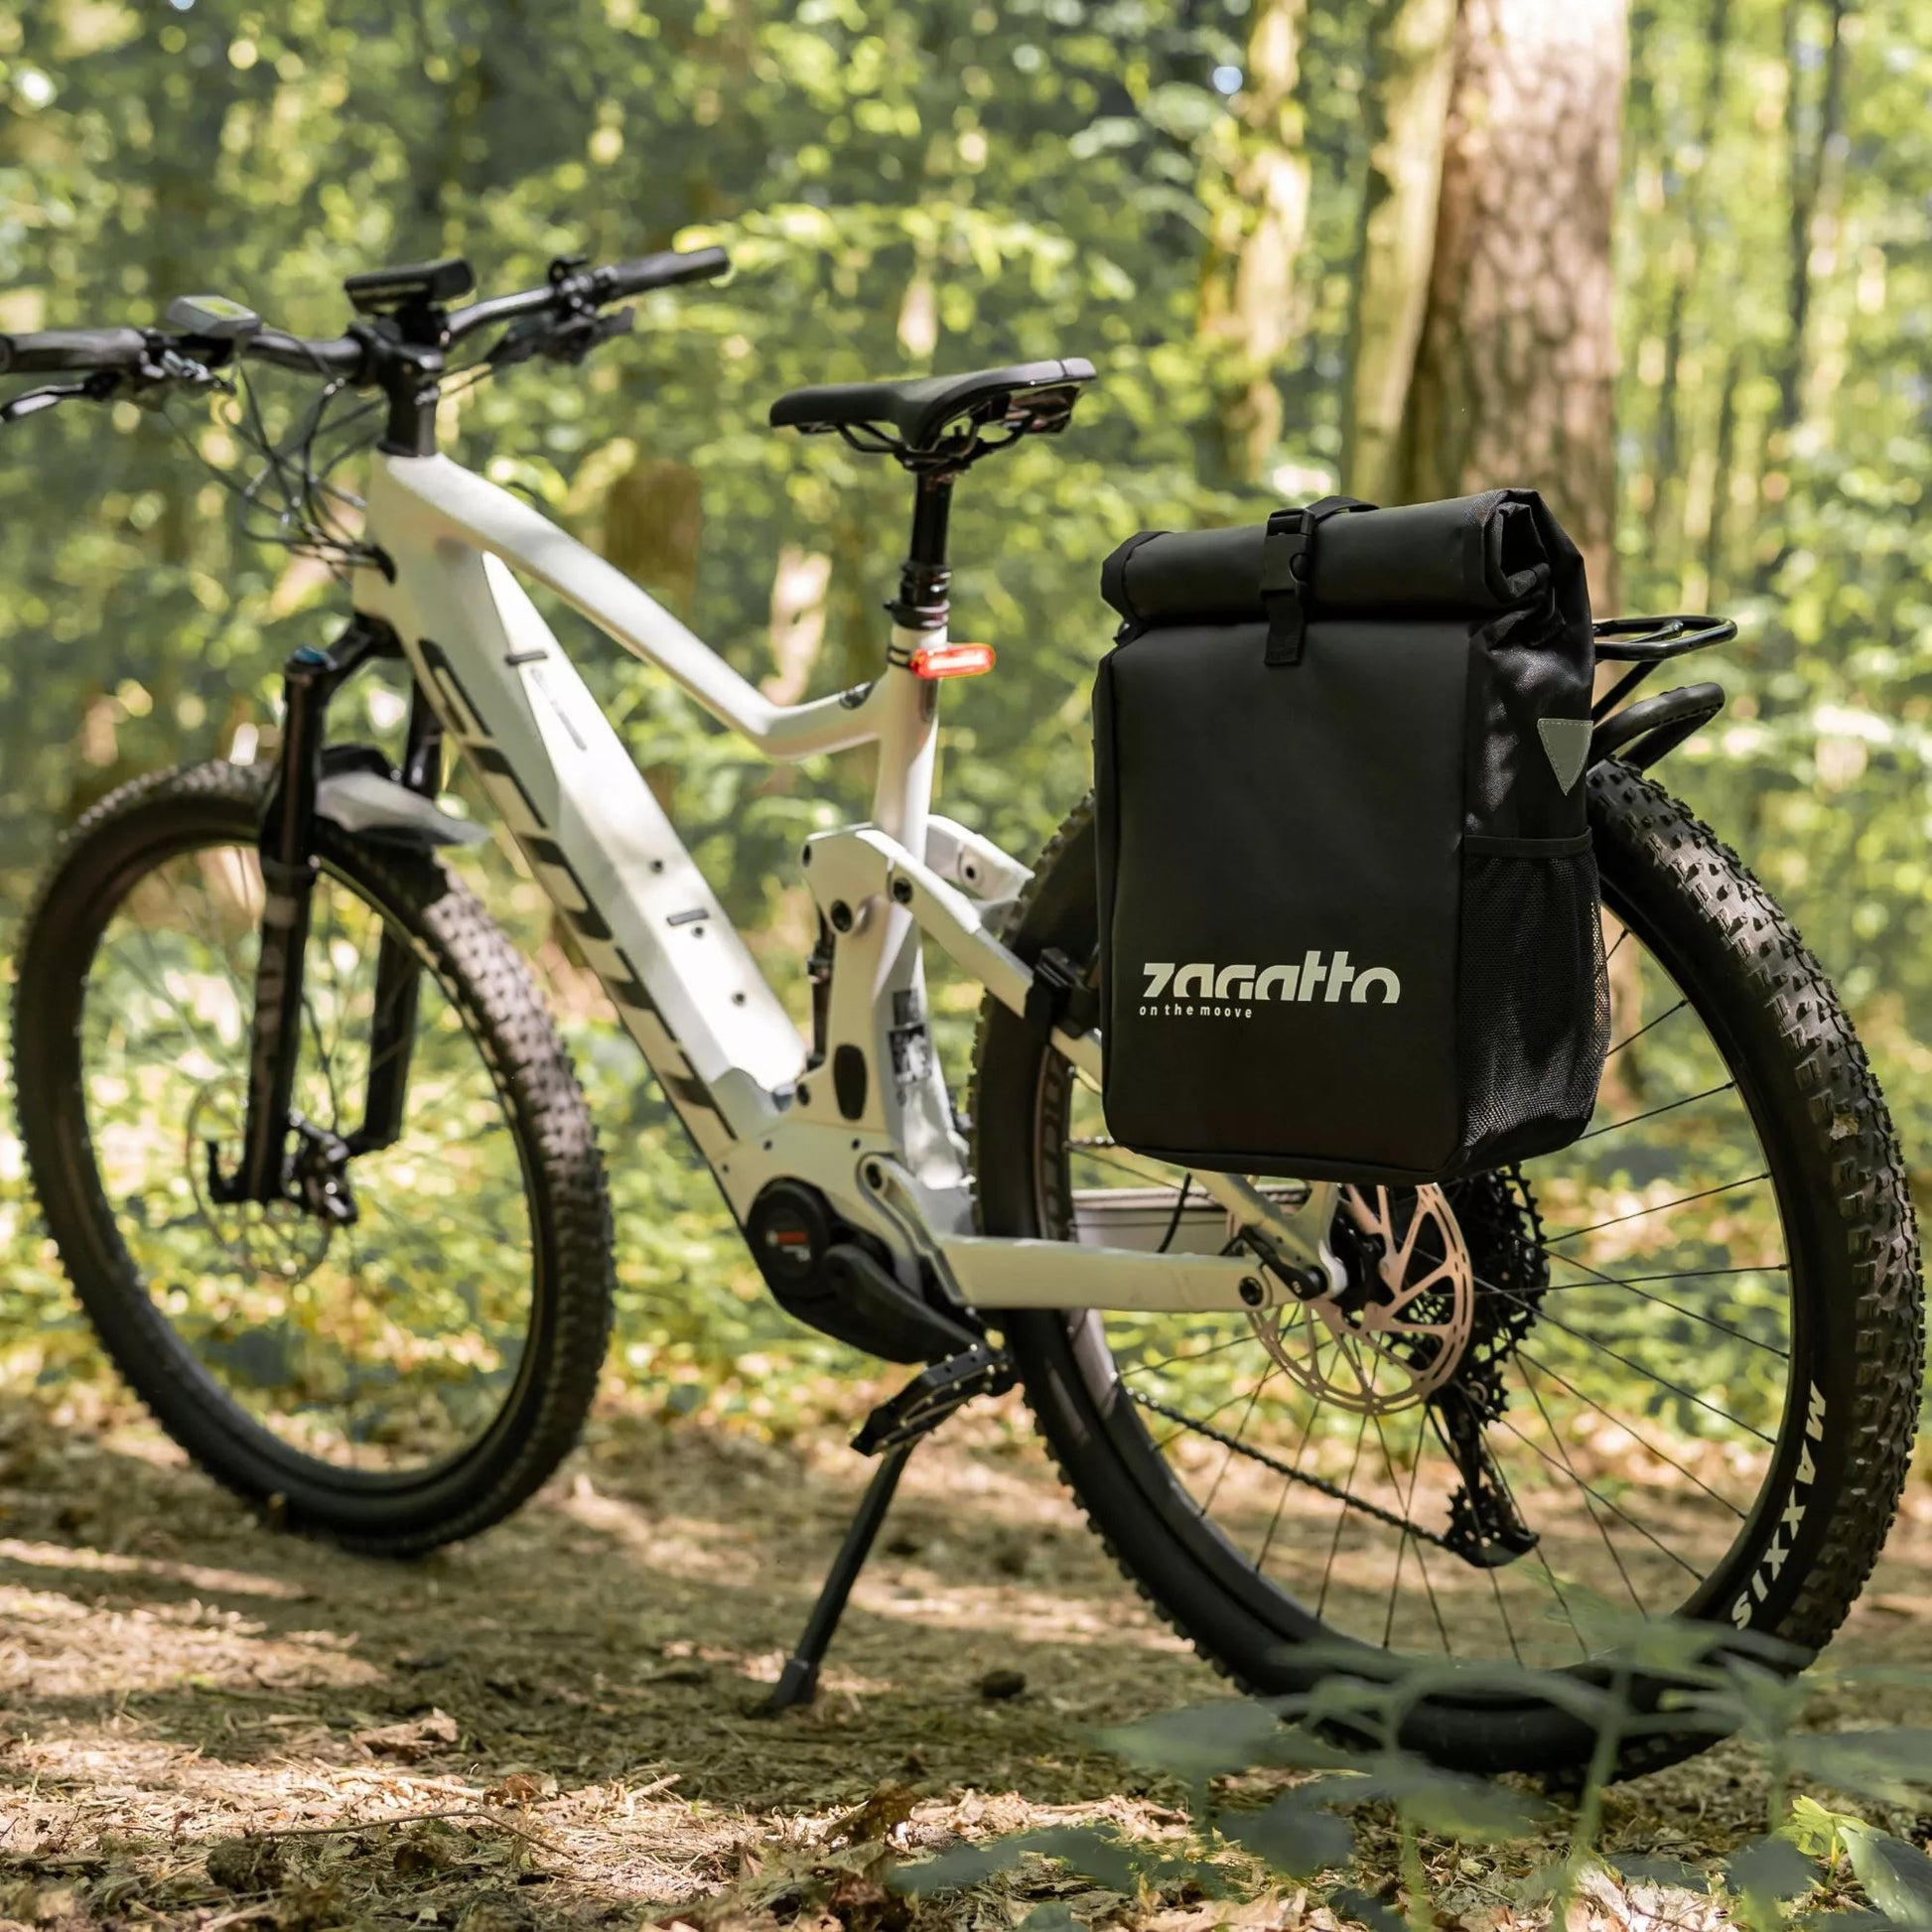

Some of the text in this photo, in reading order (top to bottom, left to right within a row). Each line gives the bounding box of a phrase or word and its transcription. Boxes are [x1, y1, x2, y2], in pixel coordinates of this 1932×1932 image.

[418, 637, 738, 1141] SCOTT
[1139, 1003, 1253, 1019] on the moove
[1731, 1380, 1827, 1631] MAXXIS
